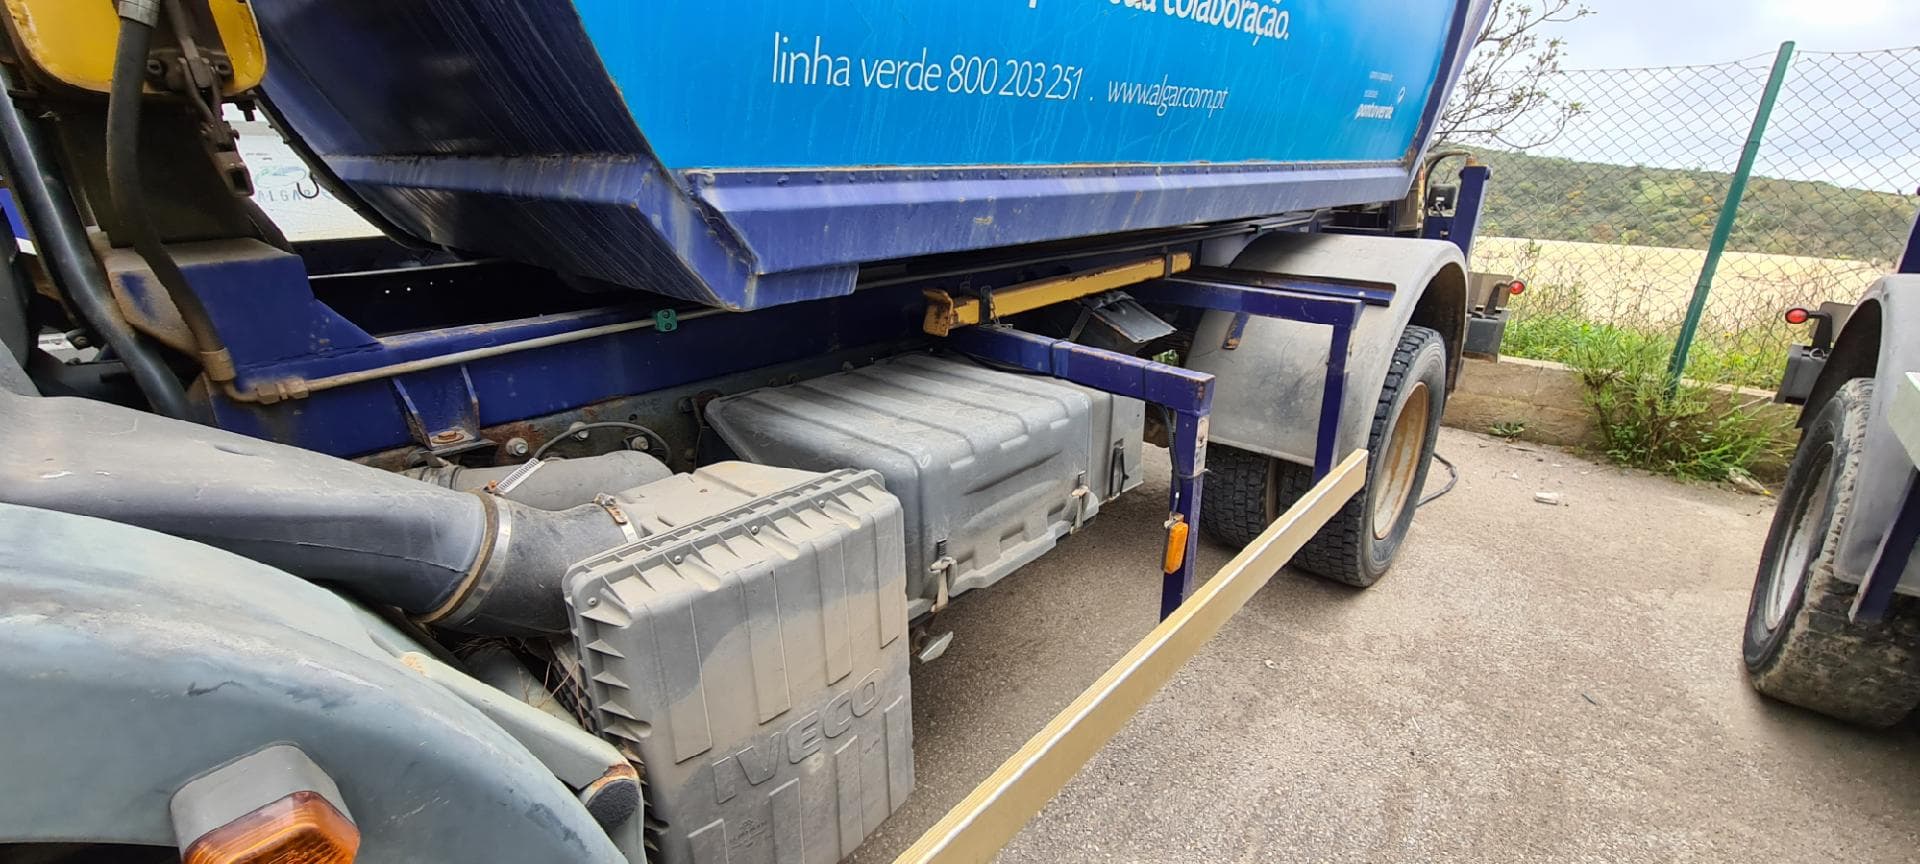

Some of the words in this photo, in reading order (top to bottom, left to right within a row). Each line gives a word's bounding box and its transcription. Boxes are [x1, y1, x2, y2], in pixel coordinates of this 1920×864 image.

[771, 31, 851, 87] linha
[860, 46, 943, 93] verde
[945, 54, 999, 95] 800
[998, 58, 1047, 98] 203
[1044, 63, 1084, 101] 251
[1107, 73, 1229, 118] www.algar.com.pt
[711, 667, 884, 806] IVECO
